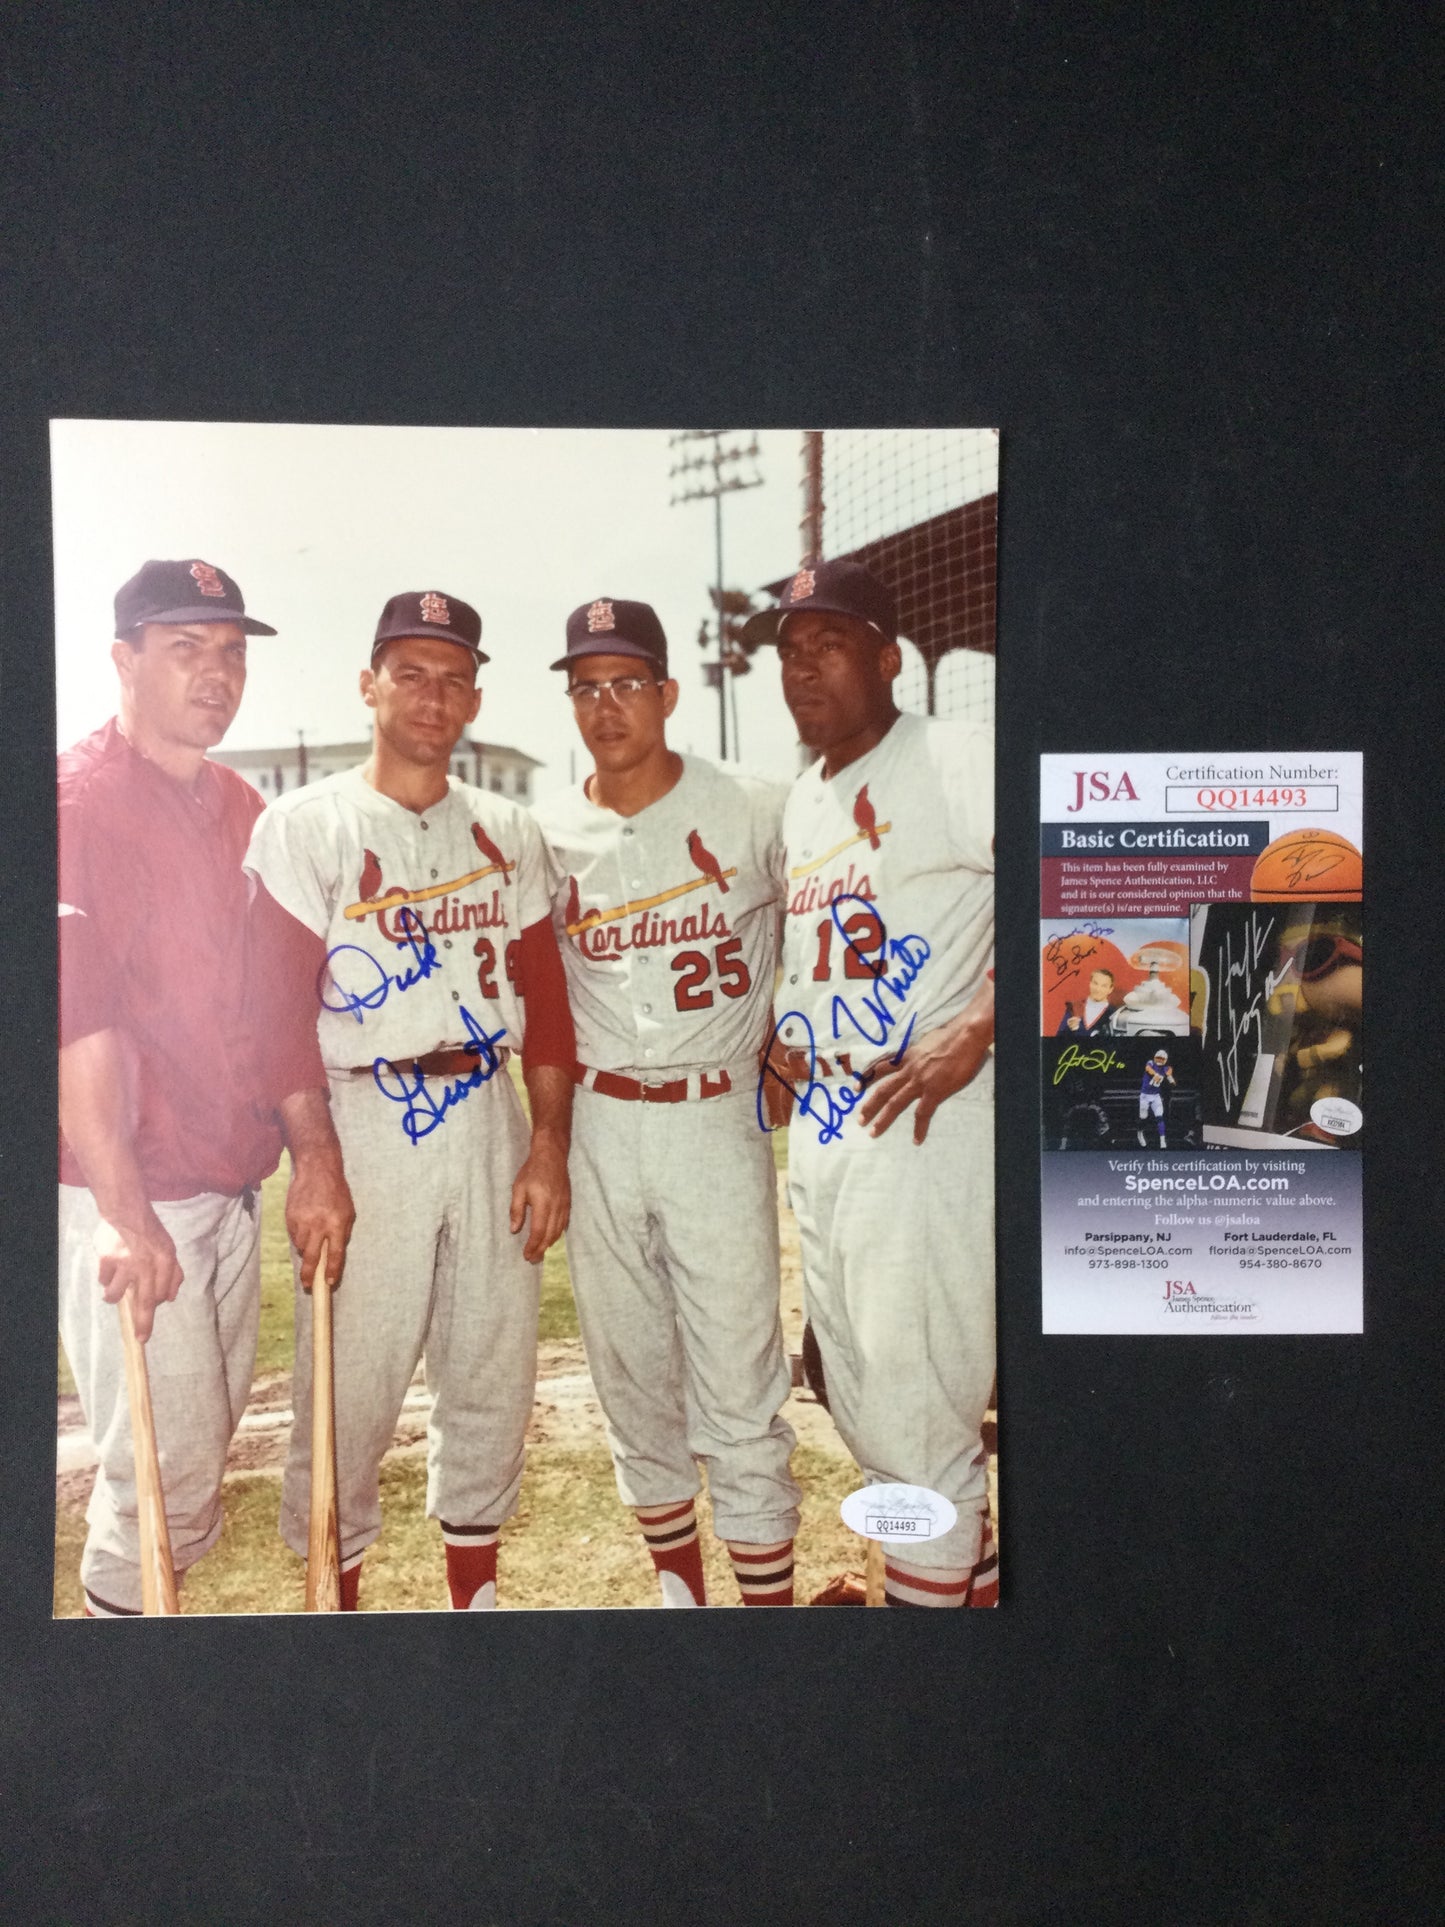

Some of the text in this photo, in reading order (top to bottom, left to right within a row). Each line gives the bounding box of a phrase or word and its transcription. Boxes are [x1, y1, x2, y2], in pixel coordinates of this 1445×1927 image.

[1166, 765, 1339, 780] Certification Number:
[1067, 771, 1140, 812] JSA
[1197, 788, 1307, 810] QQ14493
[1061, 829, 1250, 848] Basic Certification
[1061, 862, 1228, 874] This item has been fully examined by
[1061, 876, 1217, 888] James Spence Authentication, LLC
[1061, 889, 1242, 901] and it is our considered opinion that the
[1061, 903, 1183, 915] signature(s) is/are genuine.
[579, 902, 732, 961] Cardinals
[812, 912, 888, 982] 12
[671, 937, 752, 1012] 25
[1109, 1160, 1305, 1174] Verify this certification by visiting
[1125, 1175, 1289, 1193] SpenceLOA.com
[1077, 1195, 1336, 1210] and entering the alpha-numeric value above.
[1155, 1214, 1260, 1228] Follow us @jsaloa
[1085, 1233, 1171, 1243] Parsippany, NJ
[1224, 1232, 1336, 1242] Fort Lauderdale, FL
[1065, 1246, 1192, 1256] info@SpenceLOA.com
[1209, 1246, 1352, 1256] florida@SpenceLOA.com
[1089, 1260, 1168, 1269] 973-898-1300
[1240, 1260, 1322, 1268] 954-380-8670
[1163, 1281, 1197, 1300] JSA
[876, 1519, 916, 1533] QQ14493
